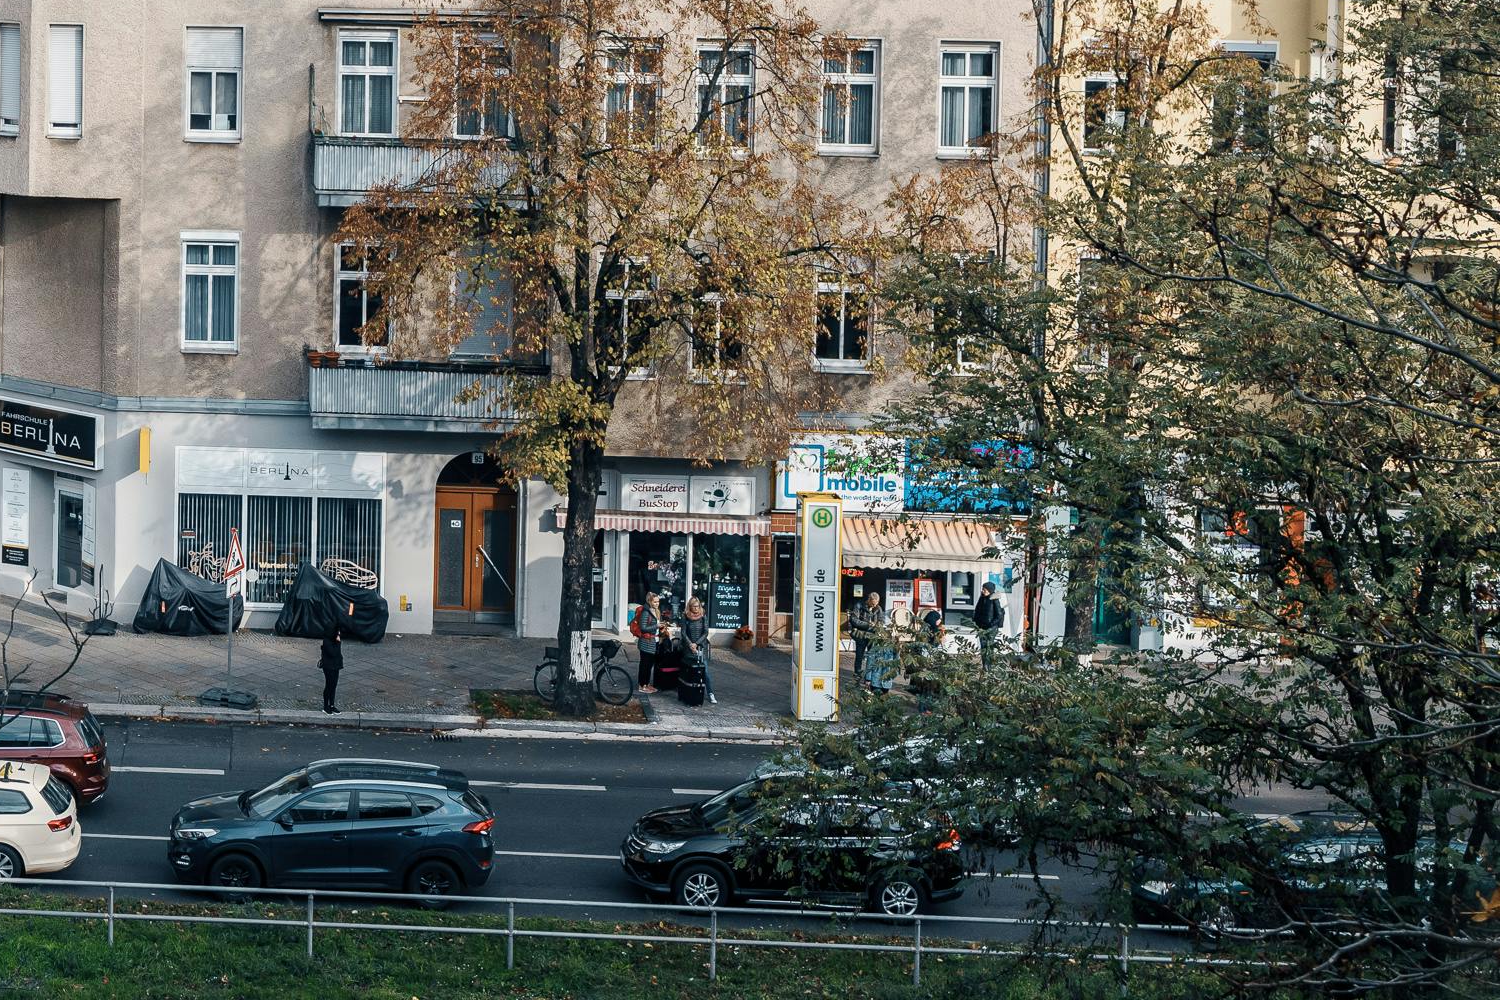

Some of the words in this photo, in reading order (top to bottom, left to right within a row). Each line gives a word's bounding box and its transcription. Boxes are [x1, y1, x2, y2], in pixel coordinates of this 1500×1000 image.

[1, 411, 48, 426] FAHRSCHULE
[1, 419, 81, 453] BERLINA
[631, 483, 686, 493] Schneiderei
[827, 476, 897, 492] mobile
[639, 499, 678, 511] BusStop
